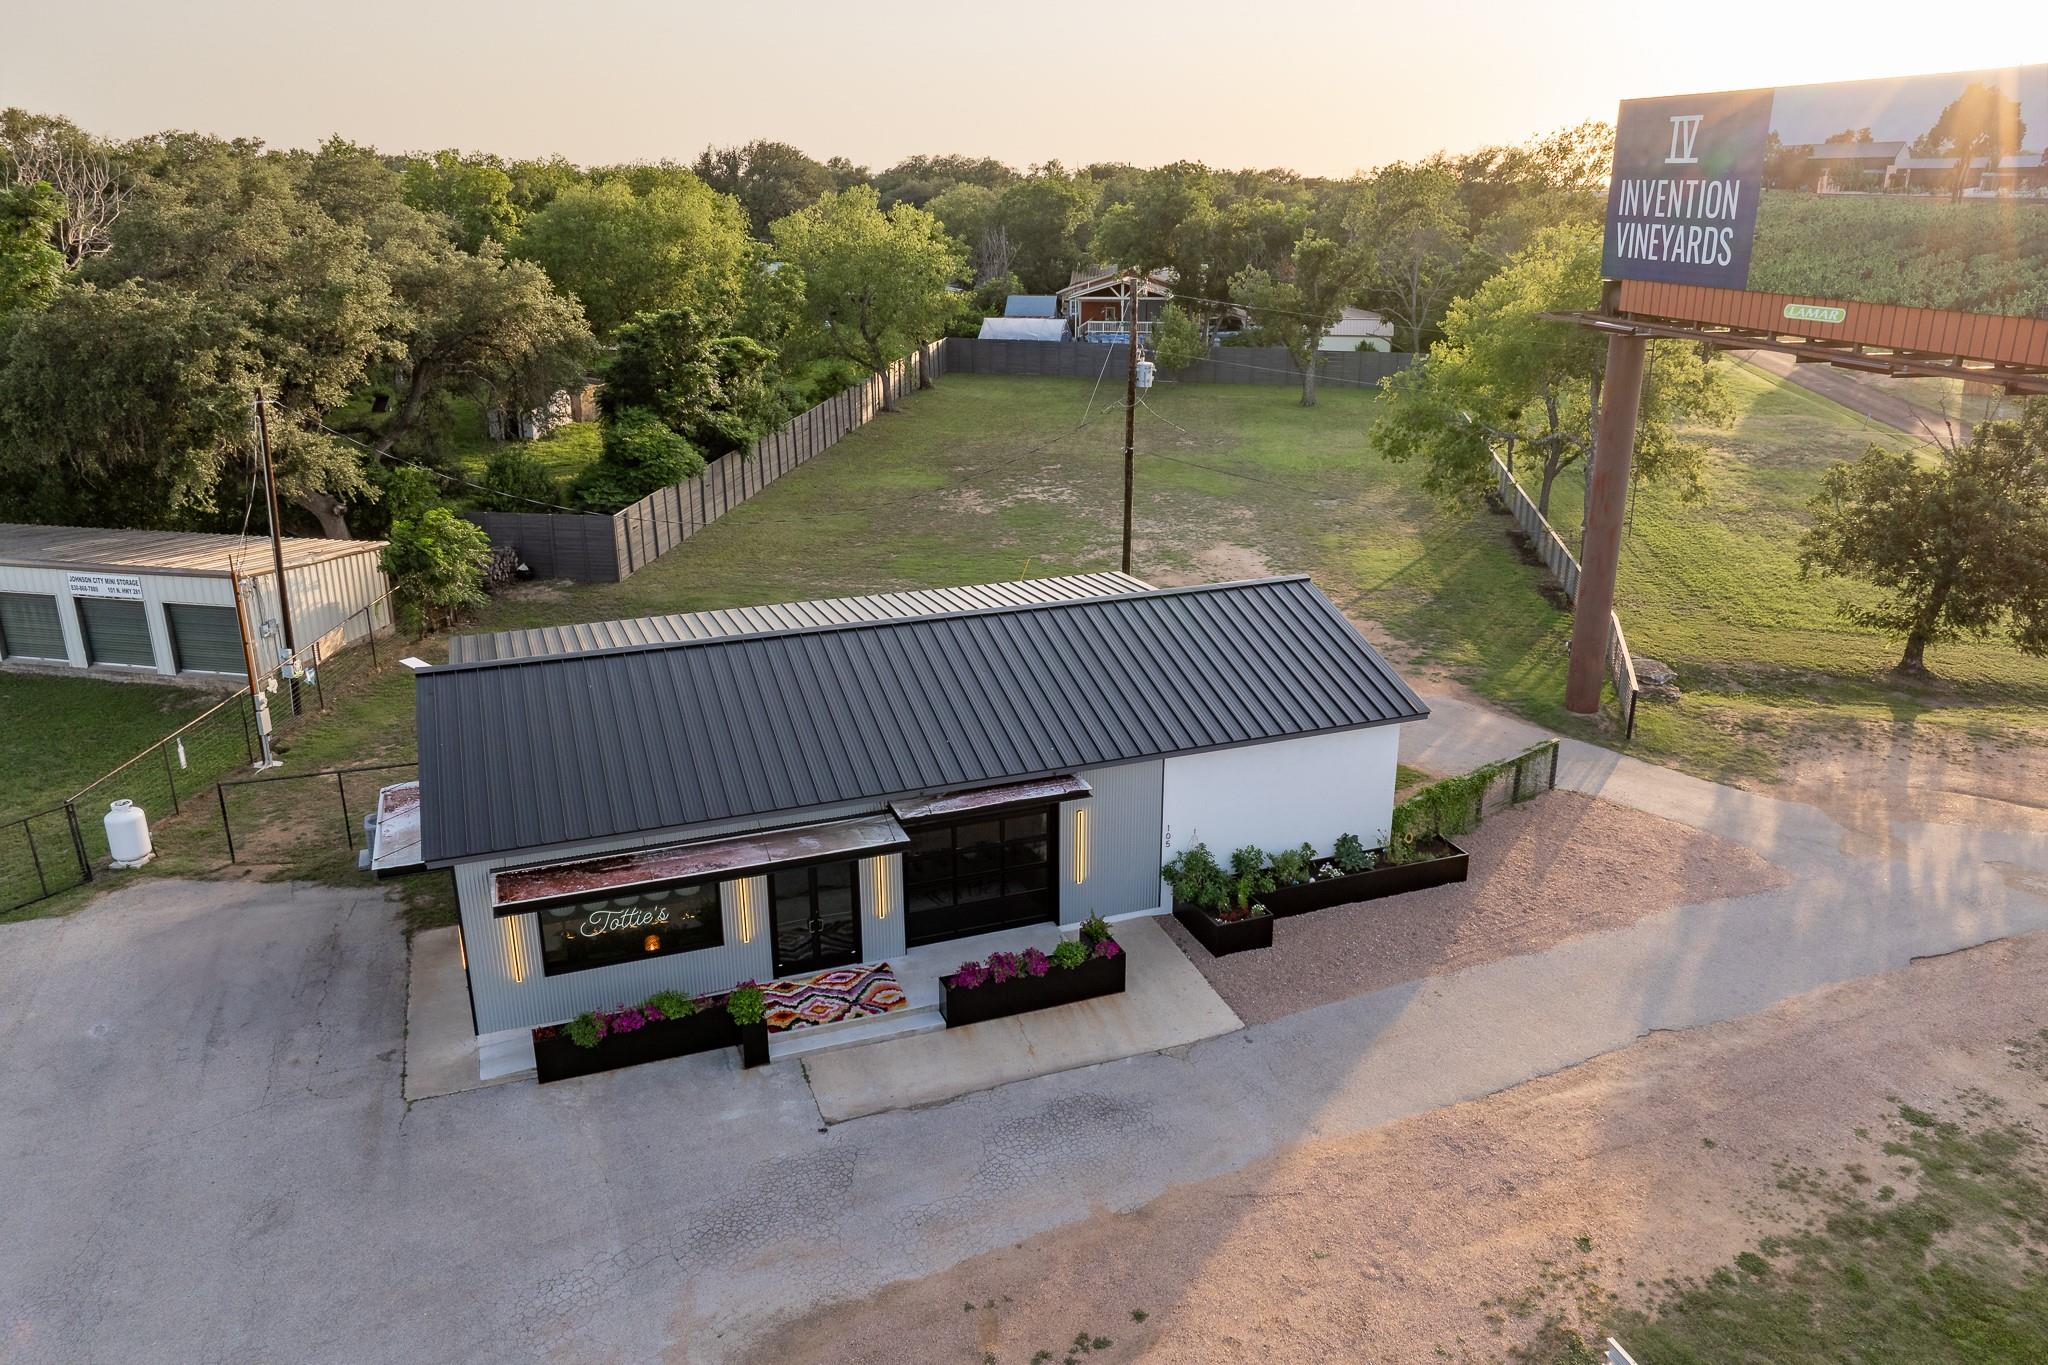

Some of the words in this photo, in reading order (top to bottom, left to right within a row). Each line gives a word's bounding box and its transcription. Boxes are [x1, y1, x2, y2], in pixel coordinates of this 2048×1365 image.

[1664, 114, 1704, 164] IV
[1618, 179, 1740, 220] INVENTION
[1617, 222, 1734, 267] VINEYARDS
[1787, 306, 1839, 320] LAMAR
[69, 575, 92, 584] JOHNSON
[116, 578, 140, 587] STORAGE
[121, 587, 132, 595] HWY
[580, 905, 670, 937] Tottie's
